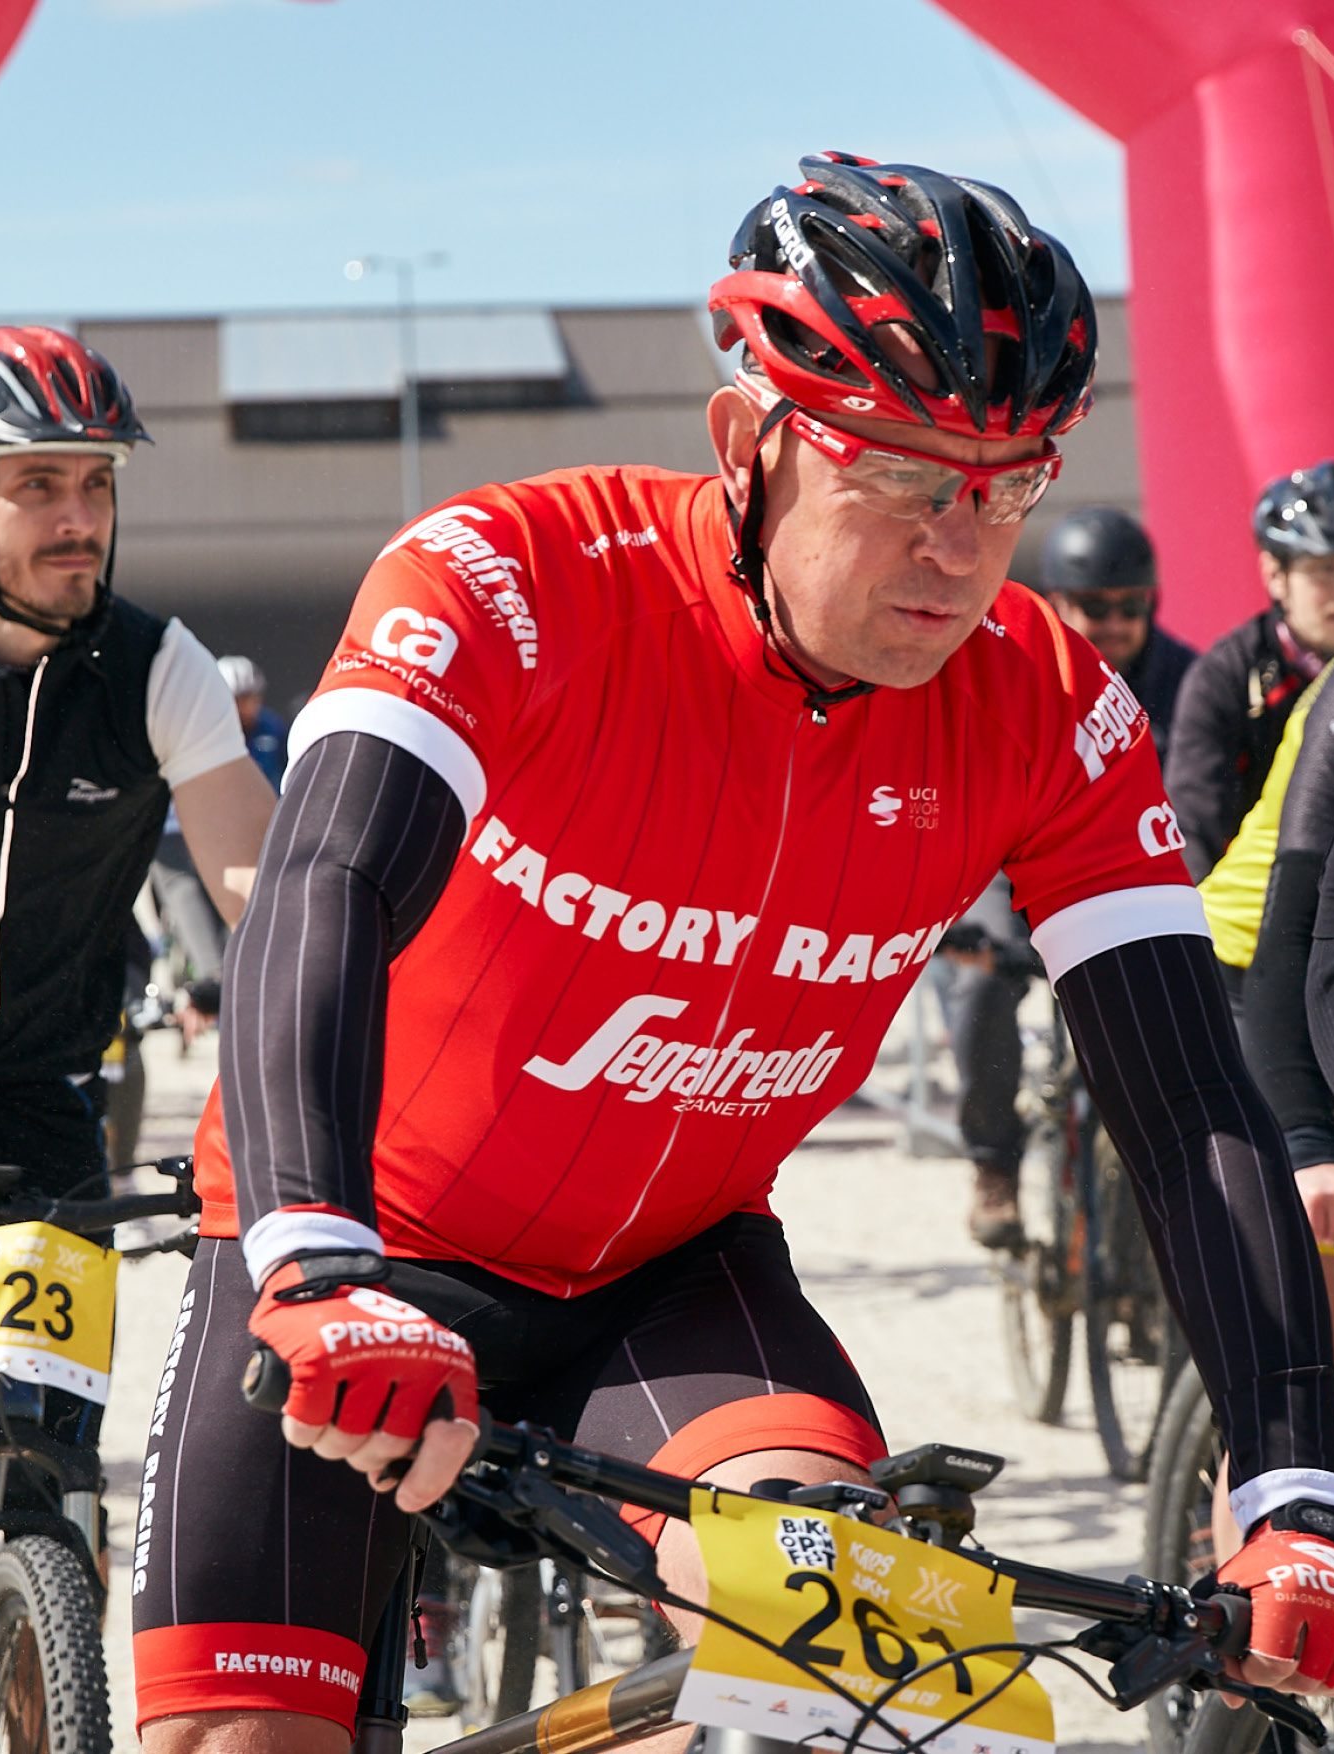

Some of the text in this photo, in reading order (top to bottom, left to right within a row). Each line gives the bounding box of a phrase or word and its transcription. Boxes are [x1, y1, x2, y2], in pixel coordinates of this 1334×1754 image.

[774, 212, 810, 270] GIRO
[446, 559, 506, 628] ZANETTI
[371, 606, 459, 678] ca
[982, 615, 1006, 638] ING
[909, 788, 937, 801] UCI
[909, 802, 940, 815] WOR
[470, 815, 963, 984] FACTORY RACIN
[521, 994, 845, 1103] Segafredo
[672, 1098, 771, 1117] ZANETTI
[132, 1288, 196, 1597] FACTORY RACING
[945, 1454, 994, 1473] GARMIN
[787, 1550, 836, 1573] FEST
[776, 1571, 973, 1696] 261
[215, 1652, 313, 1678] FACTORY
